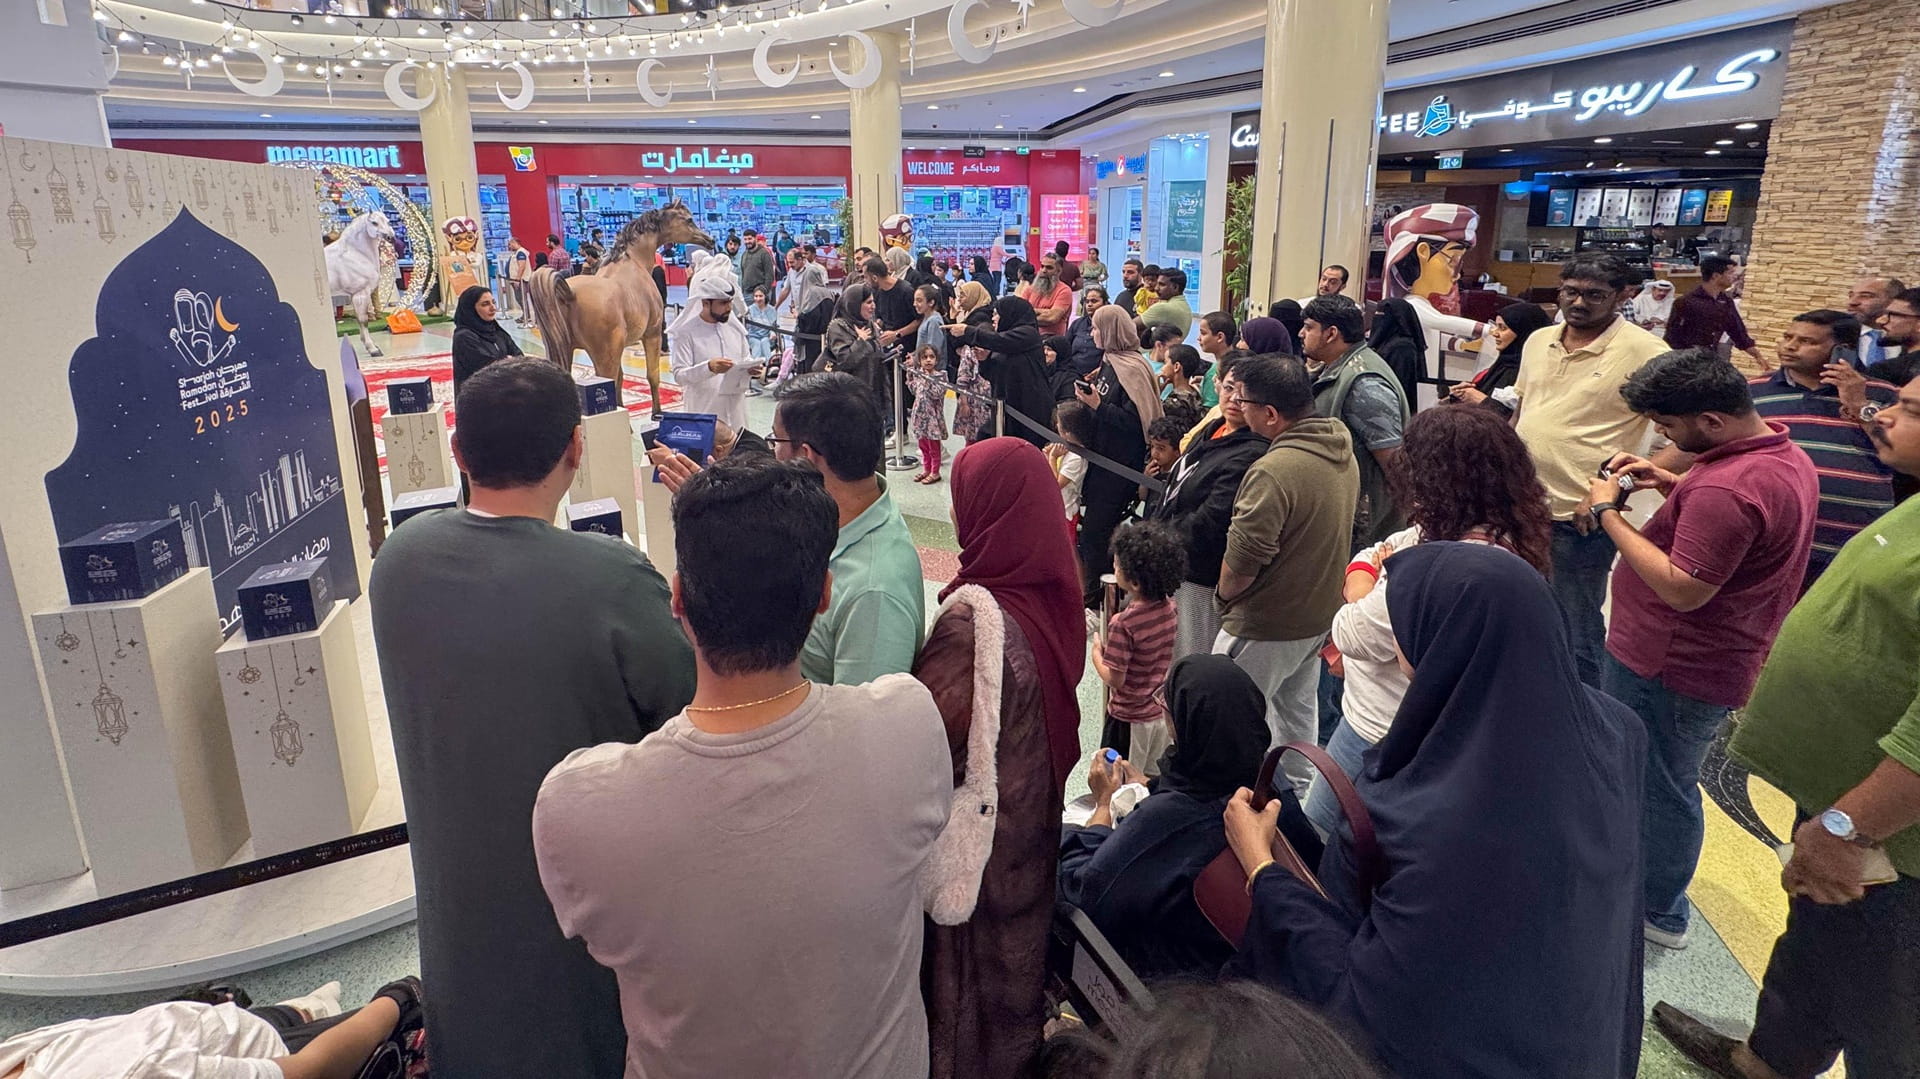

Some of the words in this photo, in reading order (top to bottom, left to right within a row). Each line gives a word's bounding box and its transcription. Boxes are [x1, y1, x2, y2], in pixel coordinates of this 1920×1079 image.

[1575, 49, 1776, 121] كاريبو
[1459, 90, 1573, 129] كوفي
[641, 147, 754, 174] ميغامارت
[907, 162, 955, 175] WELCOME
[180, 381, 217, 400] Ramadan
[218, 371, 250, 389] رمضان
[219, 380, 252, 399] الشارقة
[194, 399, 249, 434] 2025
